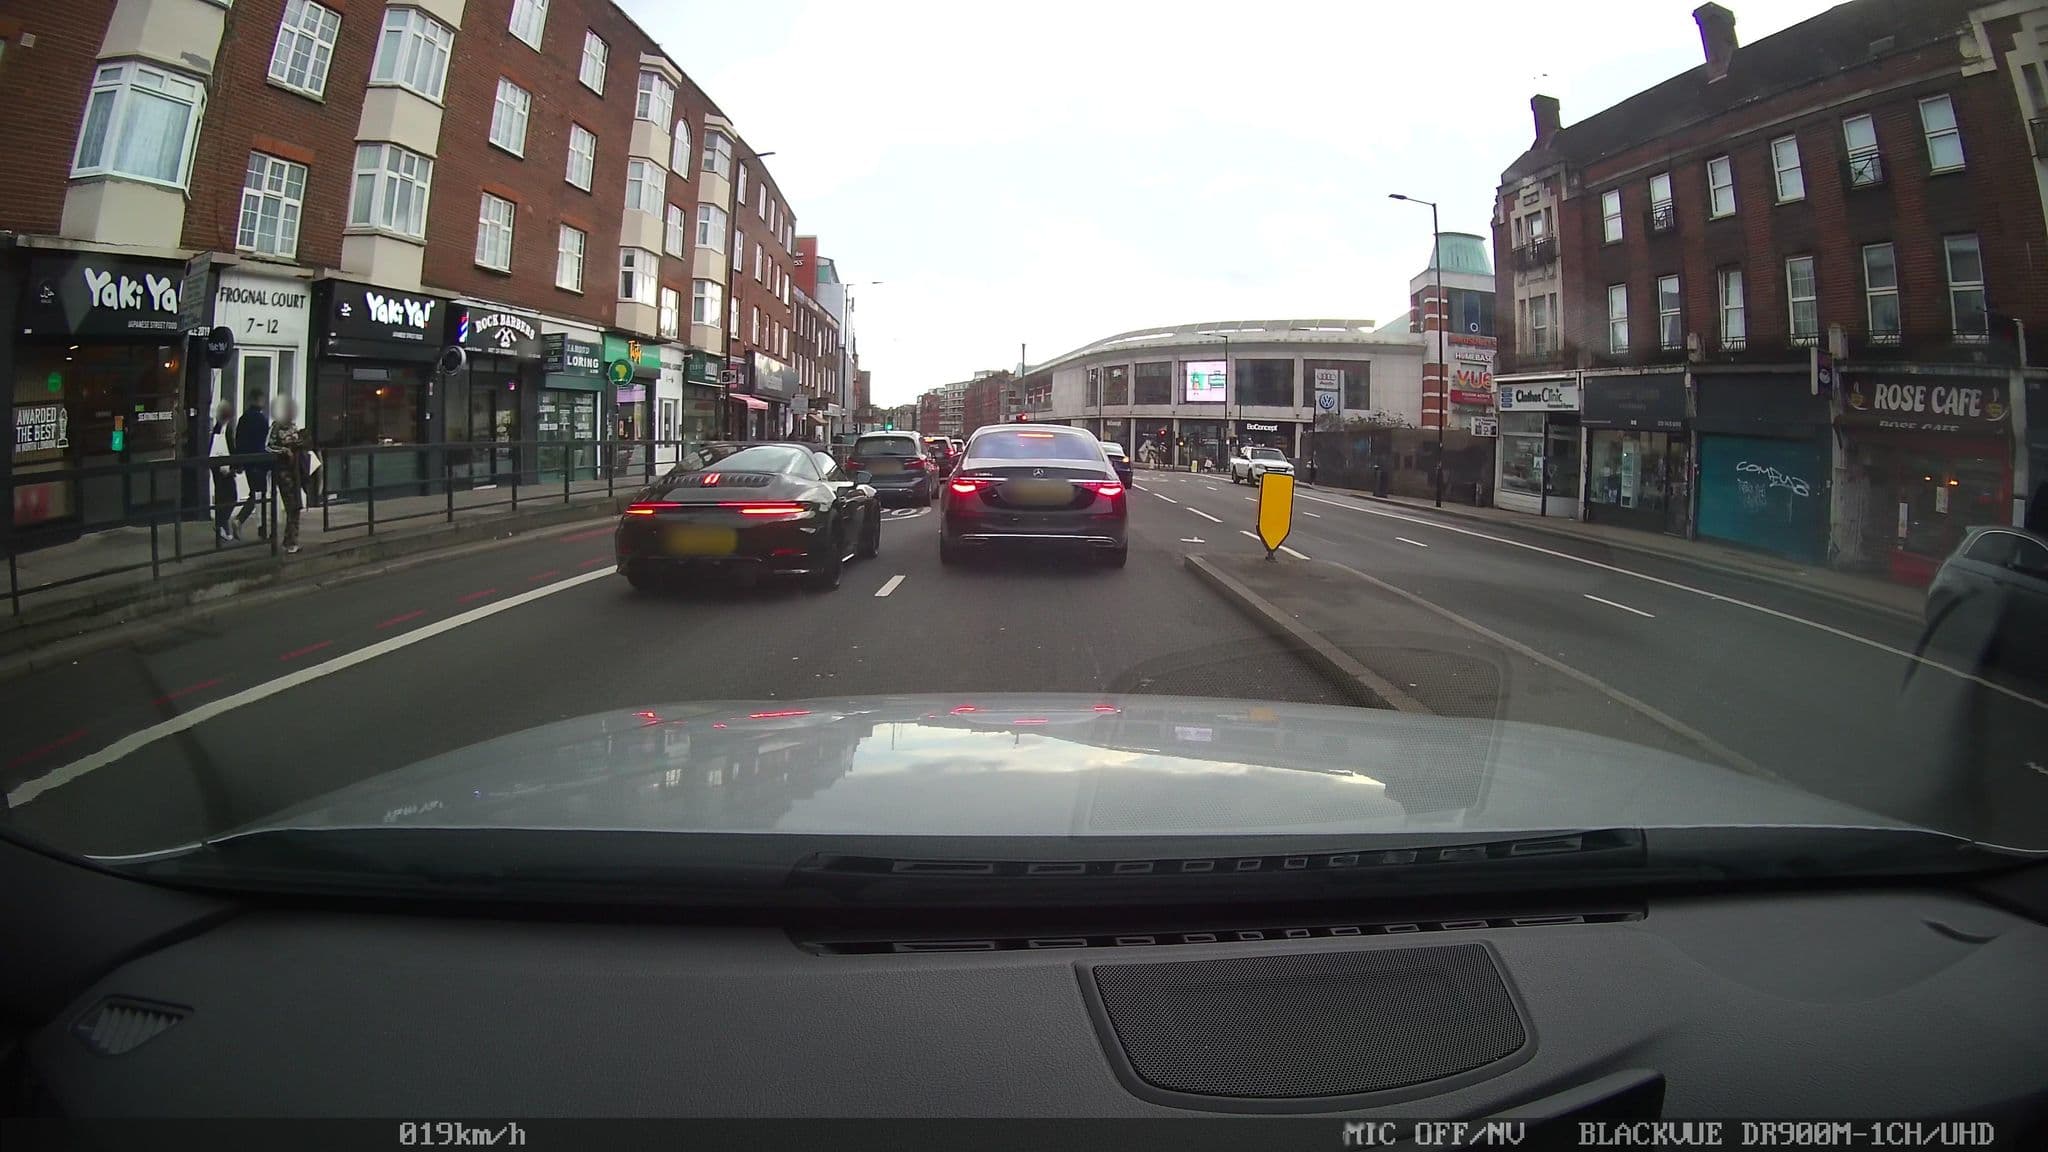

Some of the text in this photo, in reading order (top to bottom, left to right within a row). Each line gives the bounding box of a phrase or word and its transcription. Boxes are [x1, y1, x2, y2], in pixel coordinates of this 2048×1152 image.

[84, 267, 144, 311] Yaki
[219, 286, 307, 309] FROGNAL COURT
[366, 291, 405, 325] Yaki
[474, 314, 535, 340] ROCK BARBERS
[566, 355, 599, 369] LORING
[1874, 383, 1982, 417] ROSE CAFE
[16, 407, 57, 426] AWARDED
[1246, 423, 1279, 432] BoConcept
[16, 423, 57, 443] THE BEST
